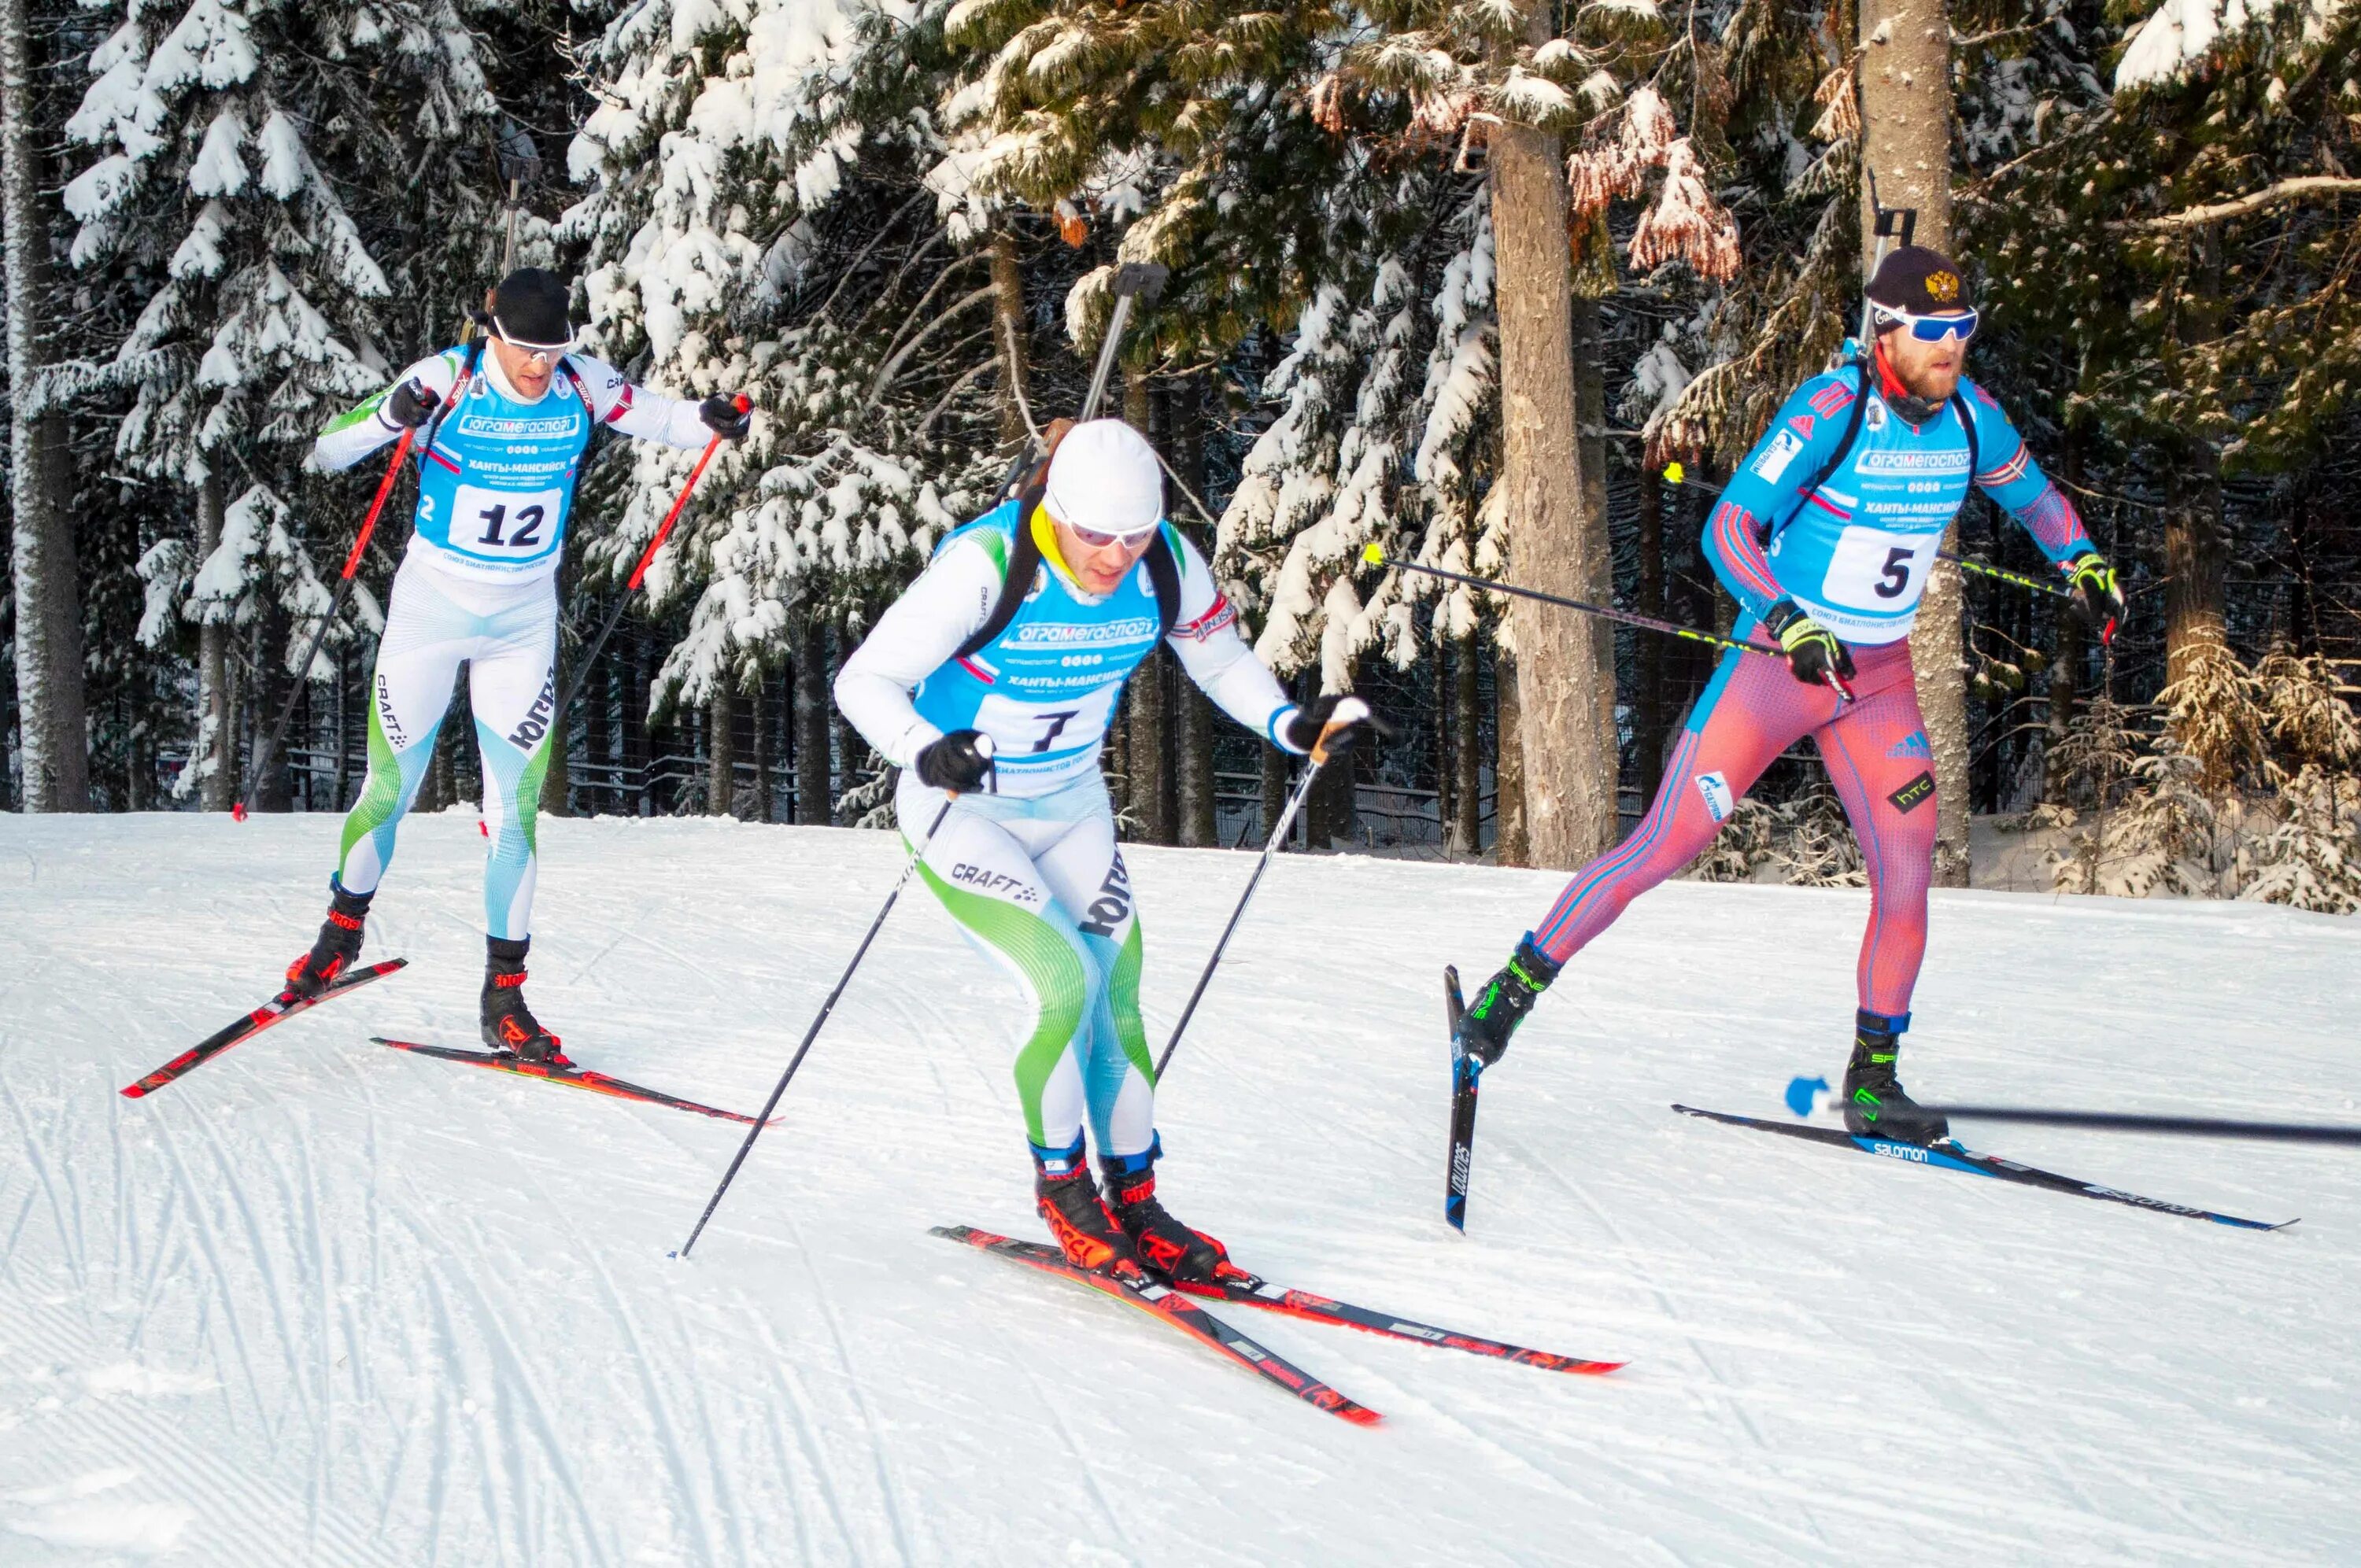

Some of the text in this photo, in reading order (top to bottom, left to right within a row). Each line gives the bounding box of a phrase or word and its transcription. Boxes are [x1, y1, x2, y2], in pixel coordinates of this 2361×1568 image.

[478, 504, 545, 547] 12
[1874, 547, 1915, 599] 5
[378, 674, 402, 732] CRAFT
[1032, 710, 1080, 752] 7
[951, 863, 1022, 893] CRAFT
[1509, 961, 1546, 991] SPINE
[1874, 1142, 1928, 1163] salomon
